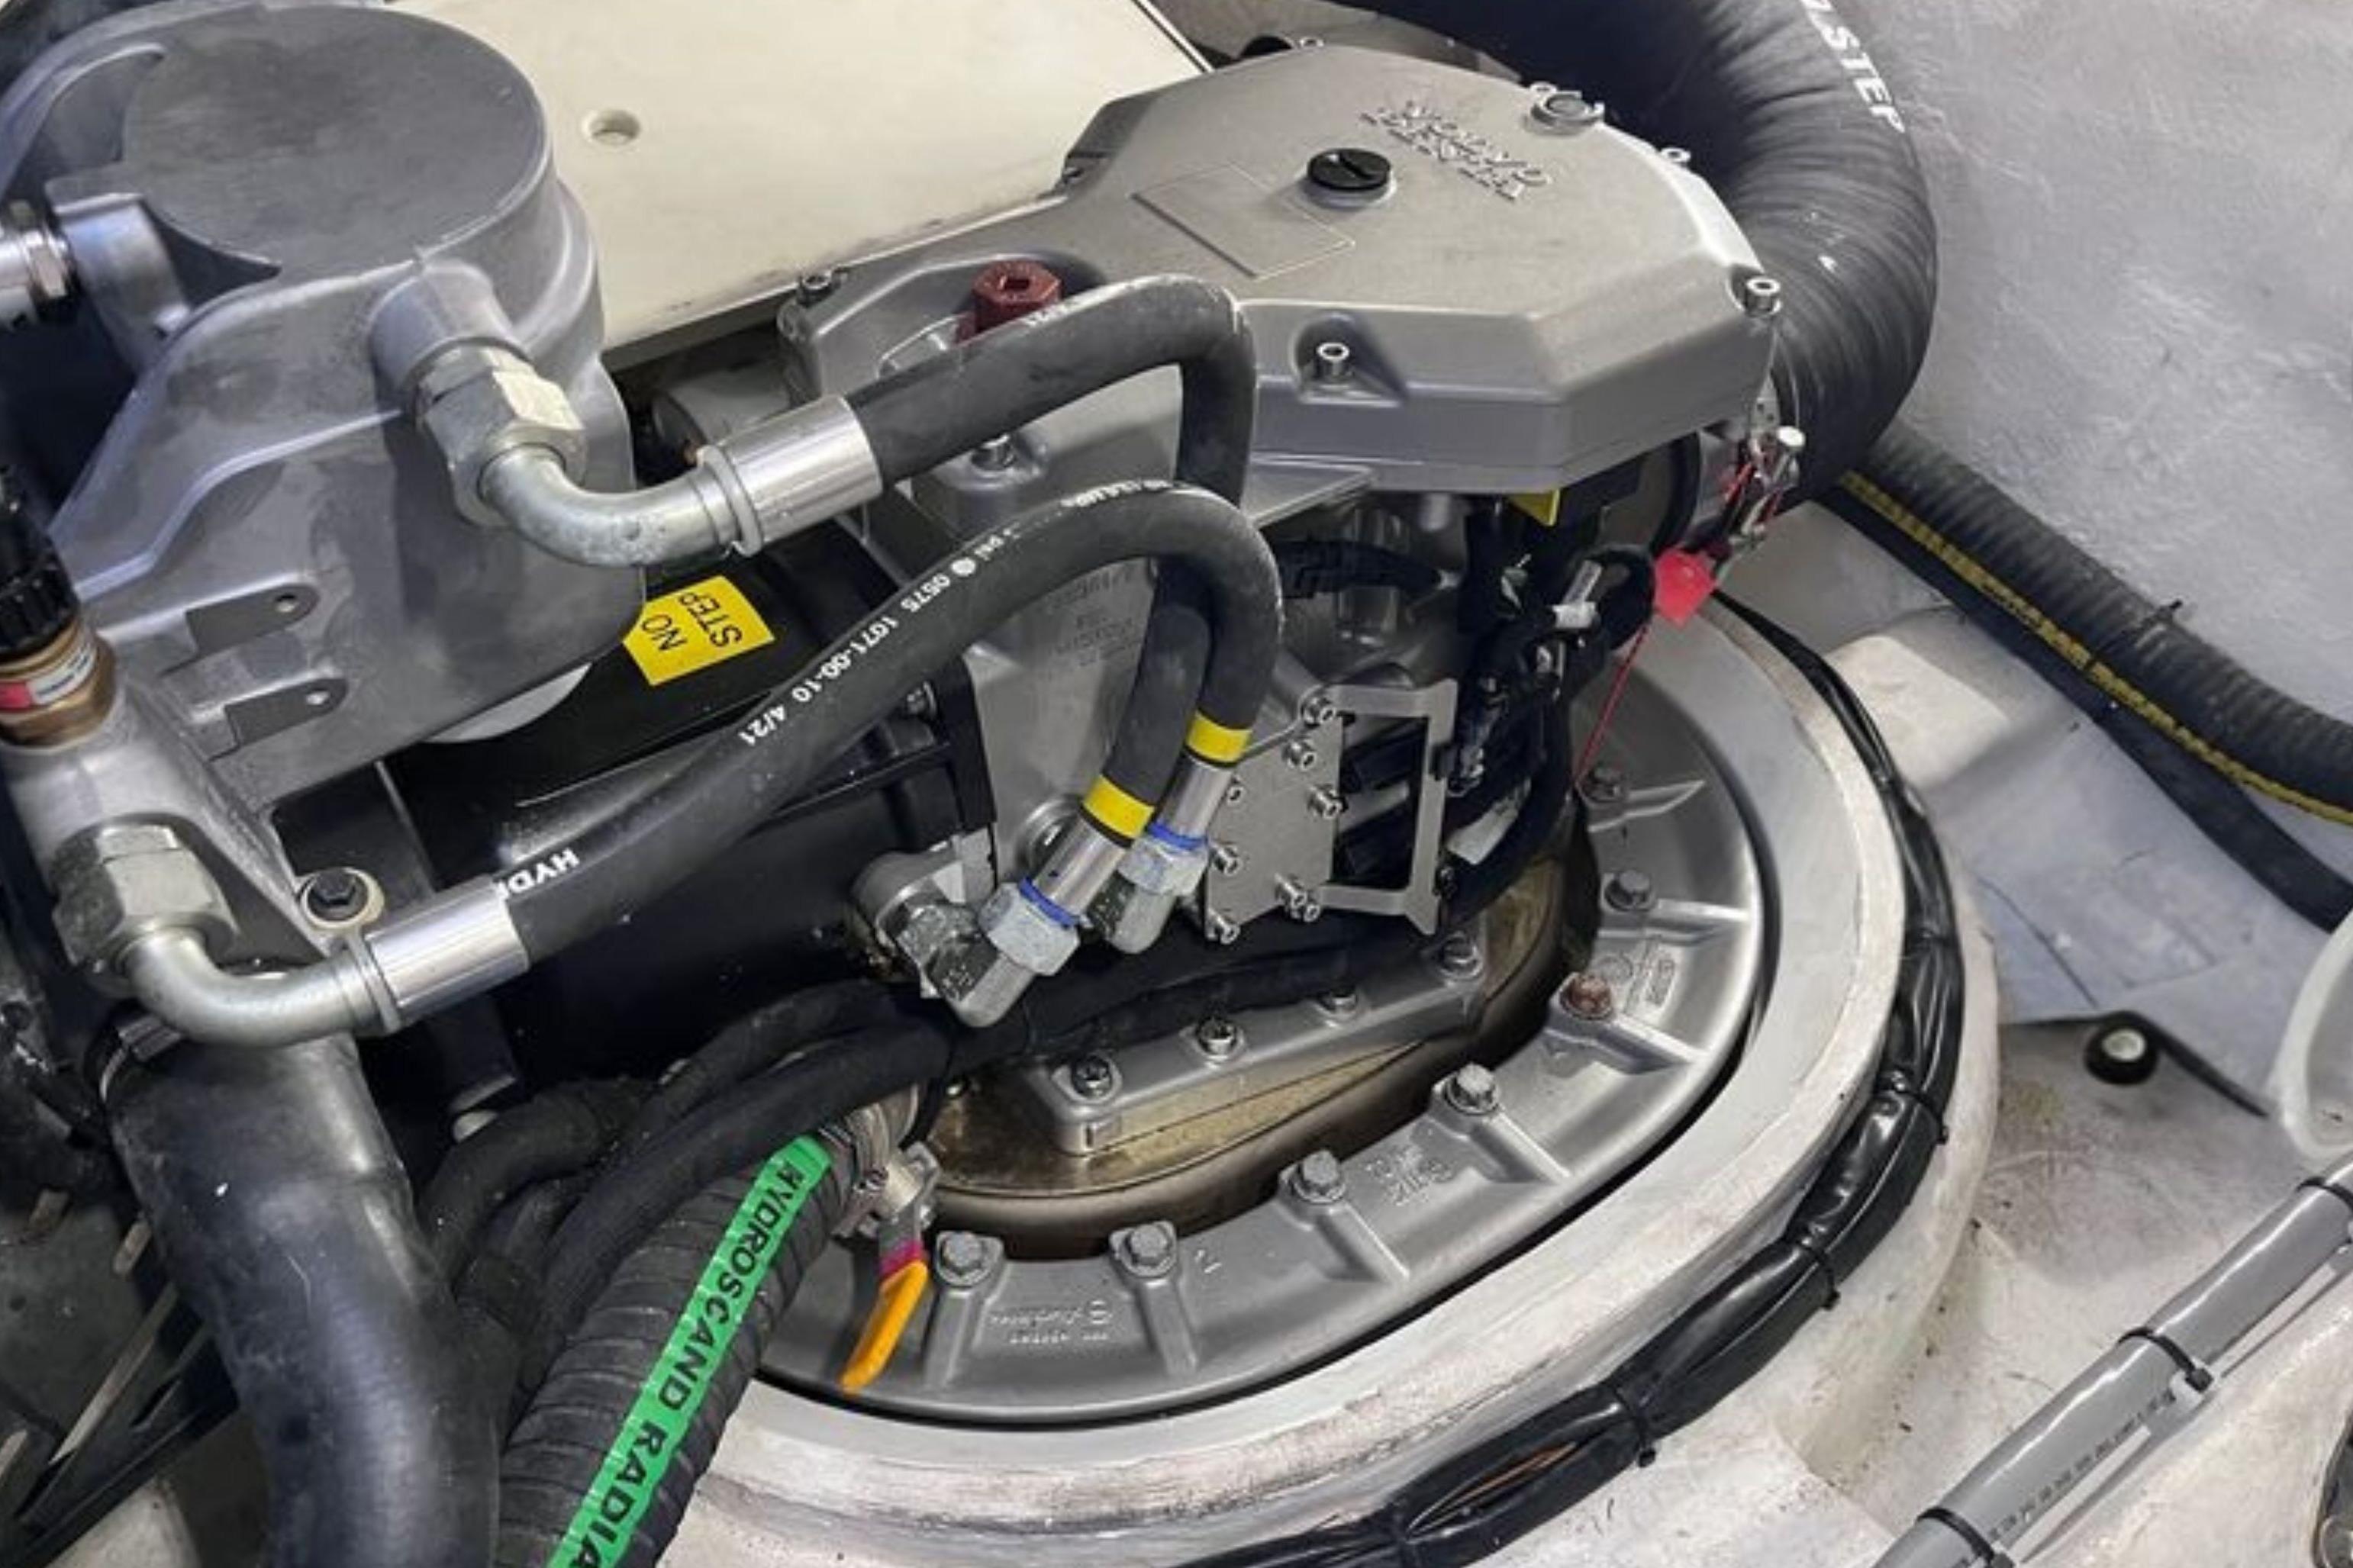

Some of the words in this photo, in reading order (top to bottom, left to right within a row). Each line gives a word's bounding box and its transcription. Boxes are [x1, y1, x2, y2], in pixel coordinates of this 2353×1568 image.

[642, 613, 687, 651] NO
[679, 592, 743, 647] STEP
[738, 704, 785, 745] 4/21
[659, 1161, 804, 1410] HYDROSCAND
